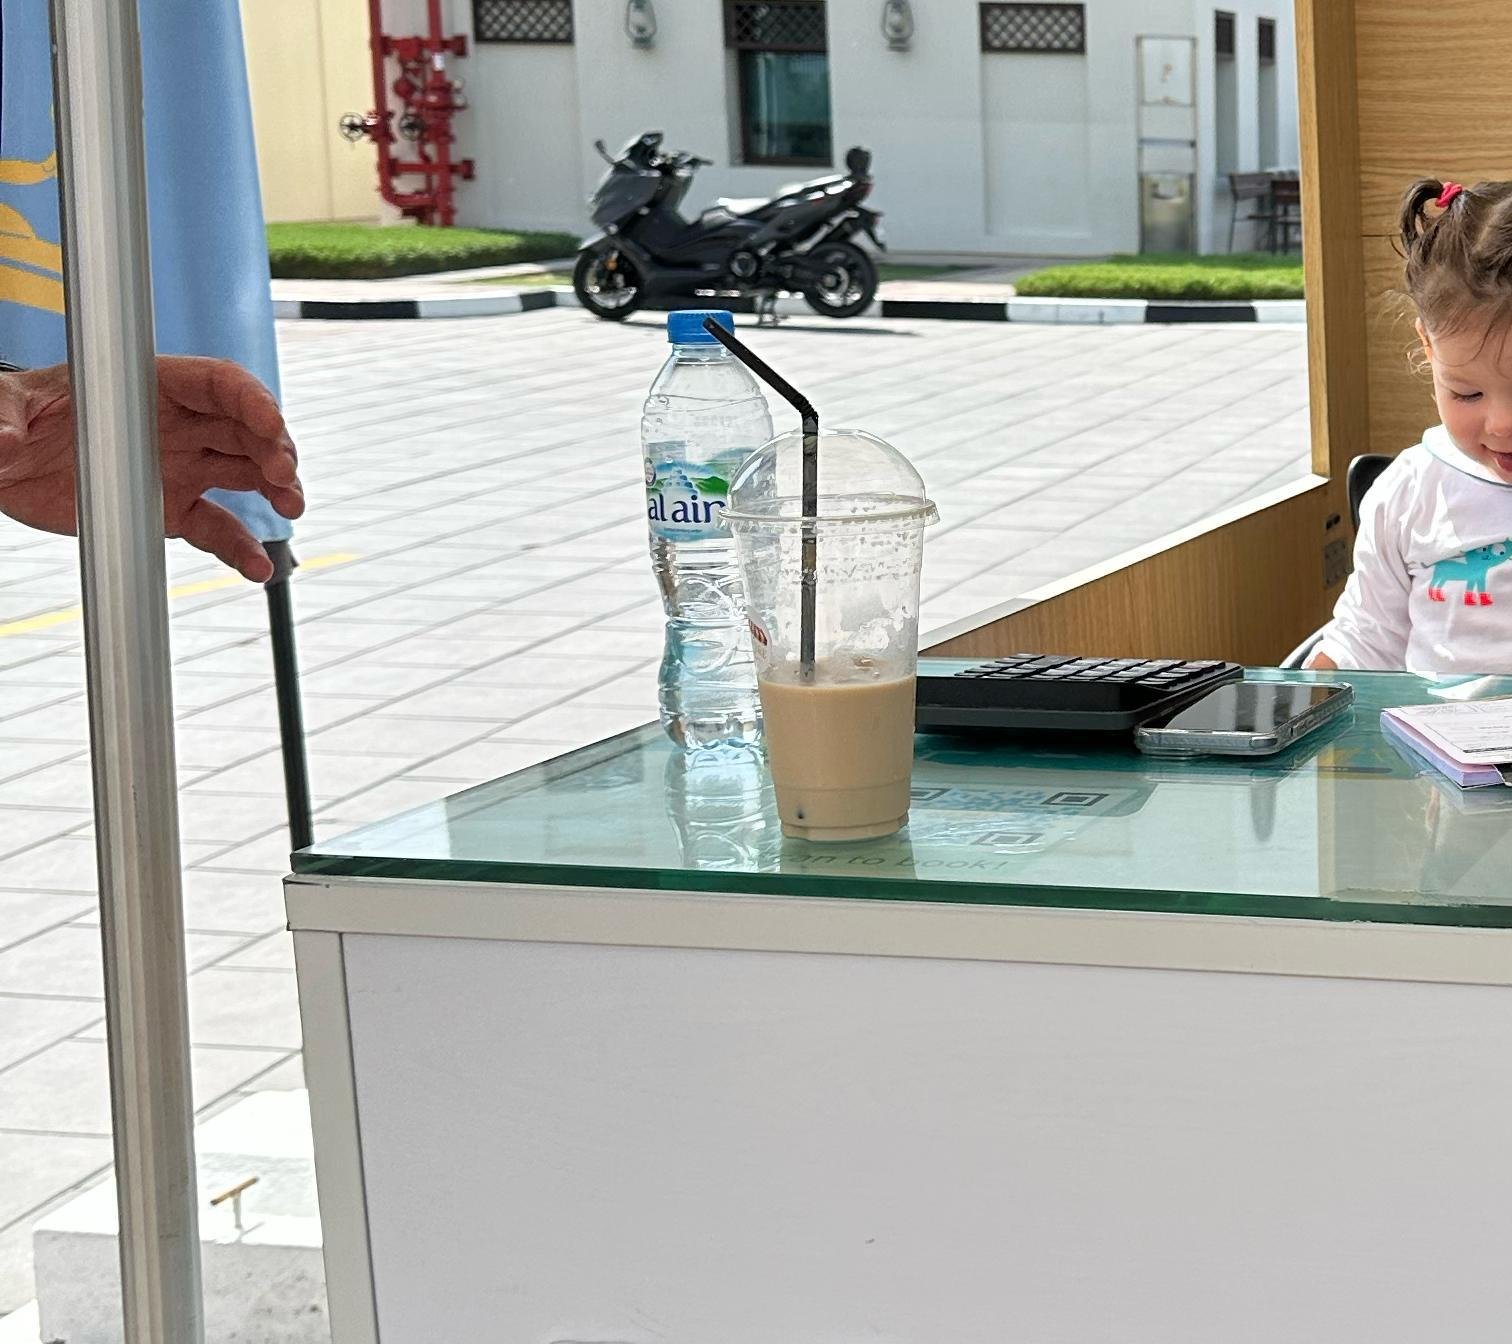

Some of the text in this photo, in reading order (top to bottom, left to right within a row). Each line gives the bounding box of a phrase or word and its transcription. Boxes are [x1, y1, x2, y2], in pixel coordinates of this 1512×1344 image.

[648, 492, 667, 522] al
[848, 855, 886, 865] to
[896, 856, 1009, 870] book!
